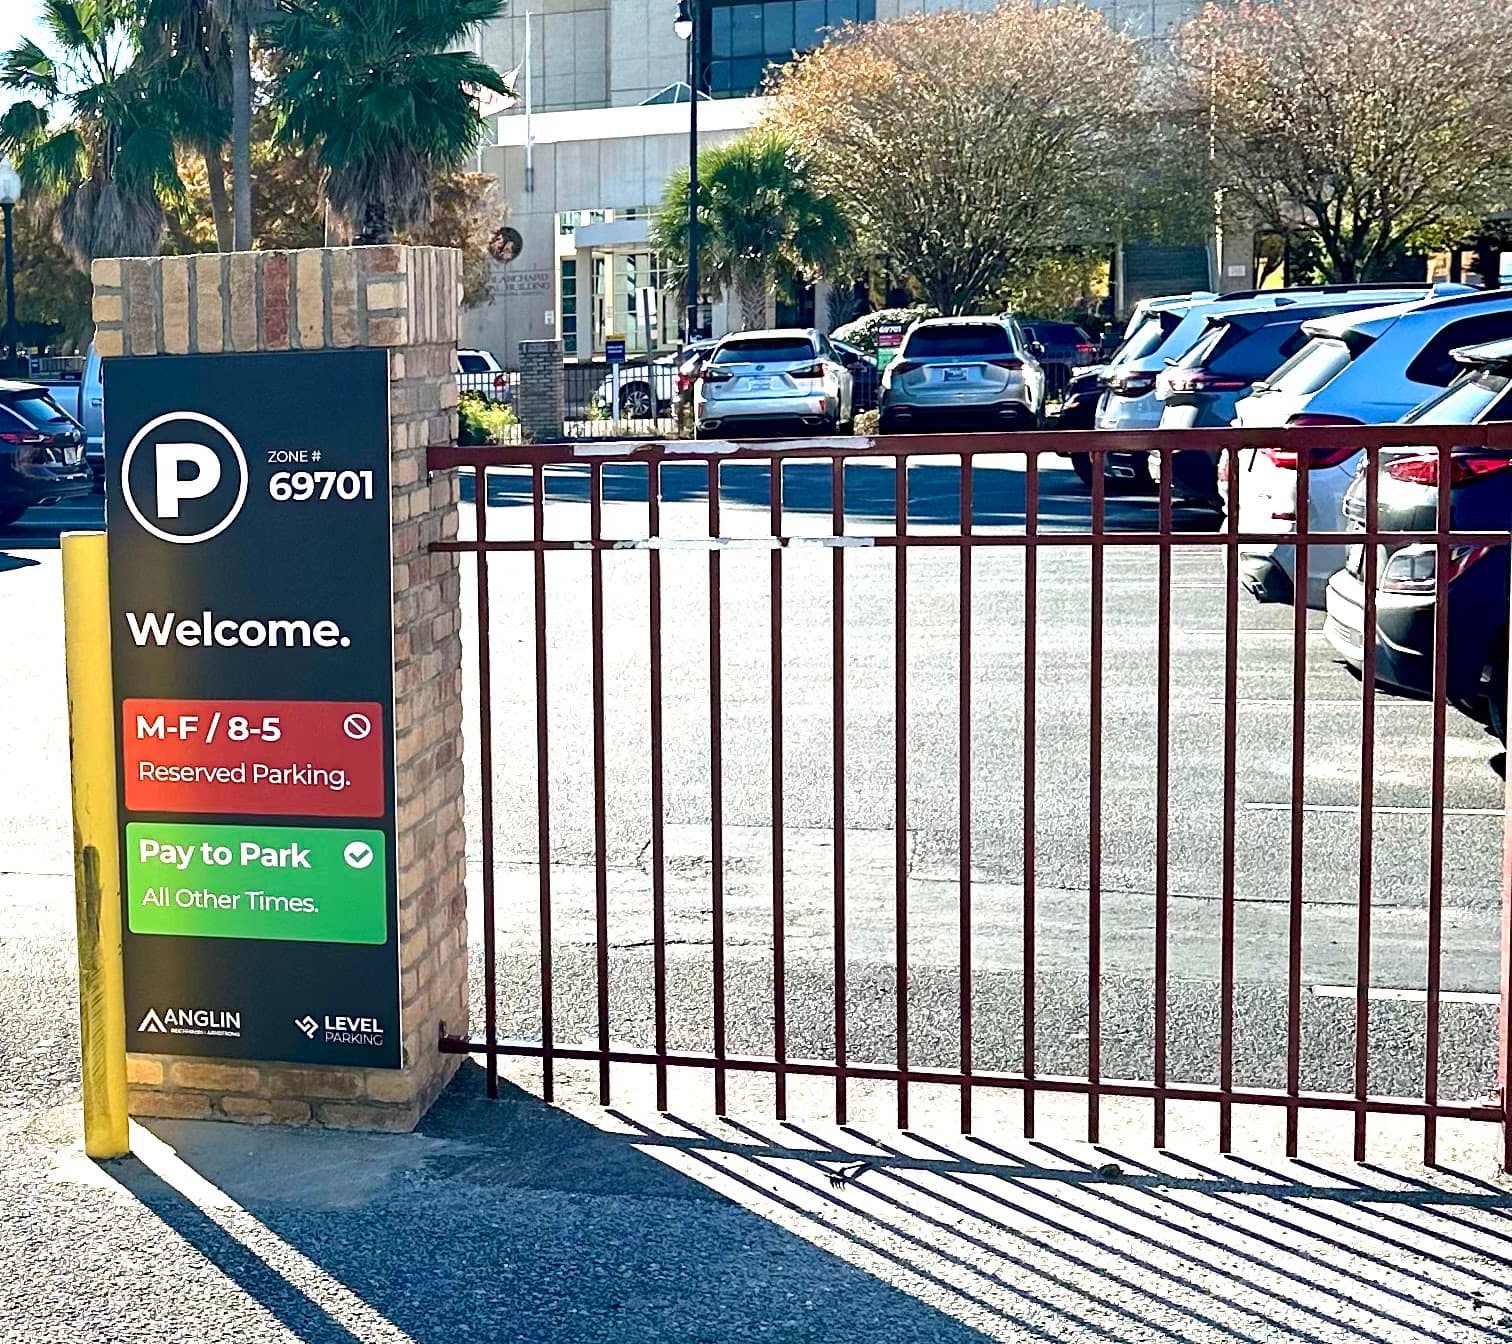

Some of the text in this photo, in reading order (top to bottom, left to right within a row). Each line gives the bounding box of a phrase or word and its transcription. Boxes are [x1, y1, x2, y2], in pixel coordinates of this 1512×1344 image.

[267, 450, 322, 463] ZONE #
[155, 443, 221, 518] P
[269, 470, 373, 500] 69701
[125, 611, 351, 647] Welcome.
[136, 712, 281, 743] M-F / 8-5
[139, 762, 351, 791] Reserved Parking.
[139, 839, 312, 871] Pay to Park
[141, 887, 319, 913] All Other Times.
[164, 1008, 241, 1029] ANGLIN
[324, 1016, 384, 1033] LEVEL
[325, 1031, 384, 1046] PARKING
